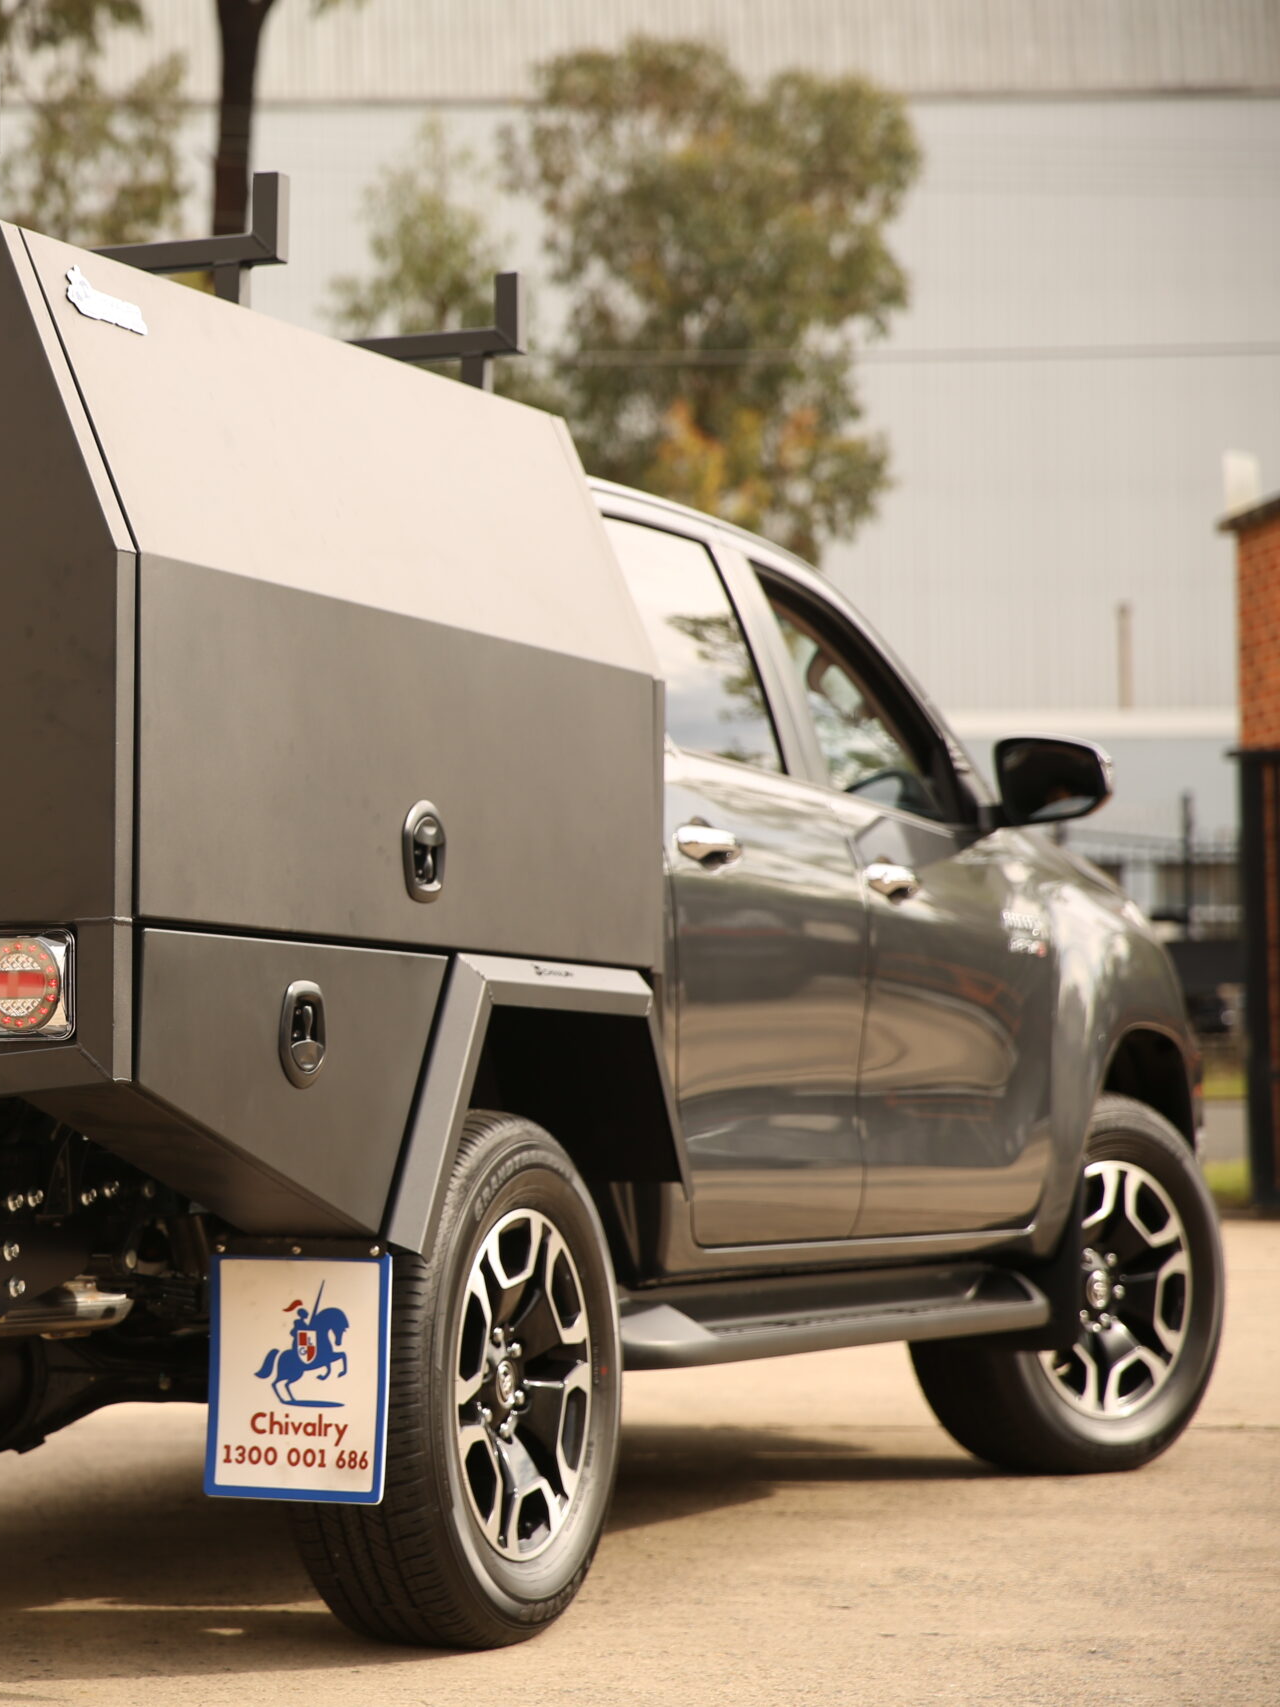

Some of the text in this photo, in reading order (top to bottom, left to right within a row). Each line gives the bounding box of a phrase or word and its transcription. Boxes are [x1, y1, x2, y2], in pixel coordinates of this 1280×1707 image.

[250, 1411, 348, 1447] Chivalry
[222, 1444, 369, 1470] 1300 001 686
